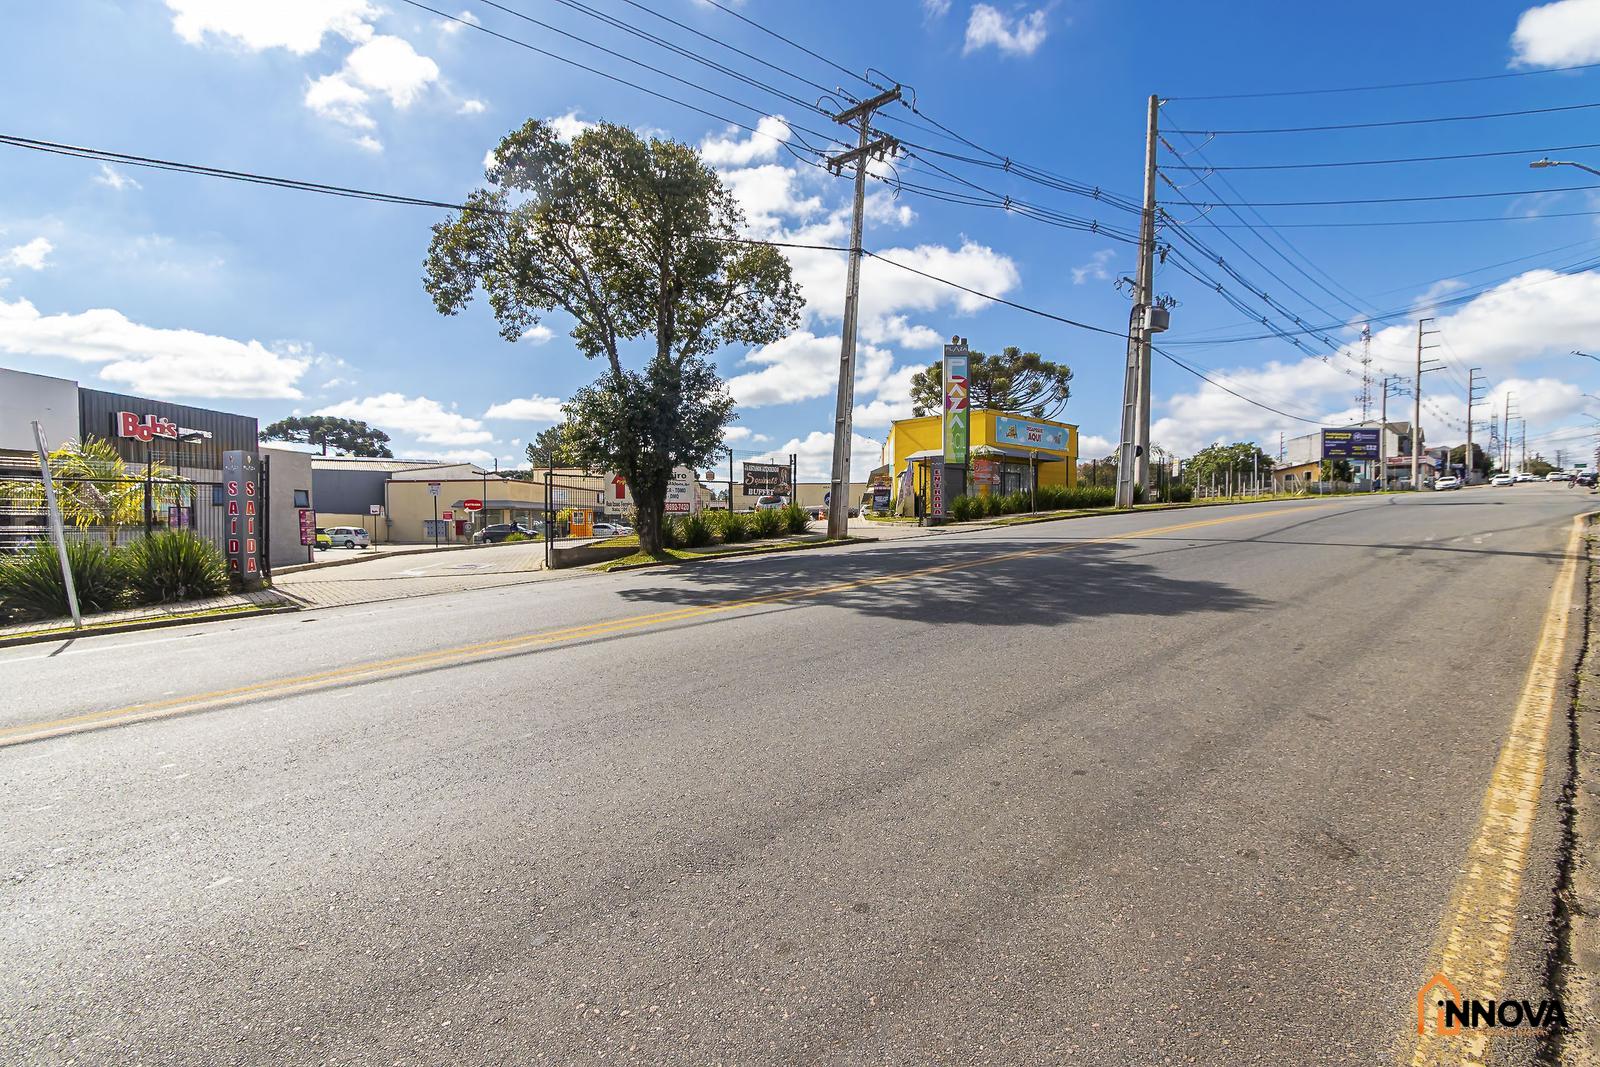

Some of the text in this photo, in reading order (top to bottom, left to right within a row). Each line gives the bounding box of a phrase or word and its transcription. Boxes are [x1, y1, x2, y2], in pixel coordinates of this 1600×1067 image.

[1027, 432, 1042, 442] AQUI
[748, 488, 775, 496] BUFFET
[228, 481, 239, 573] SAÍDA
[246, 481, 257, 572] SAÍDA
